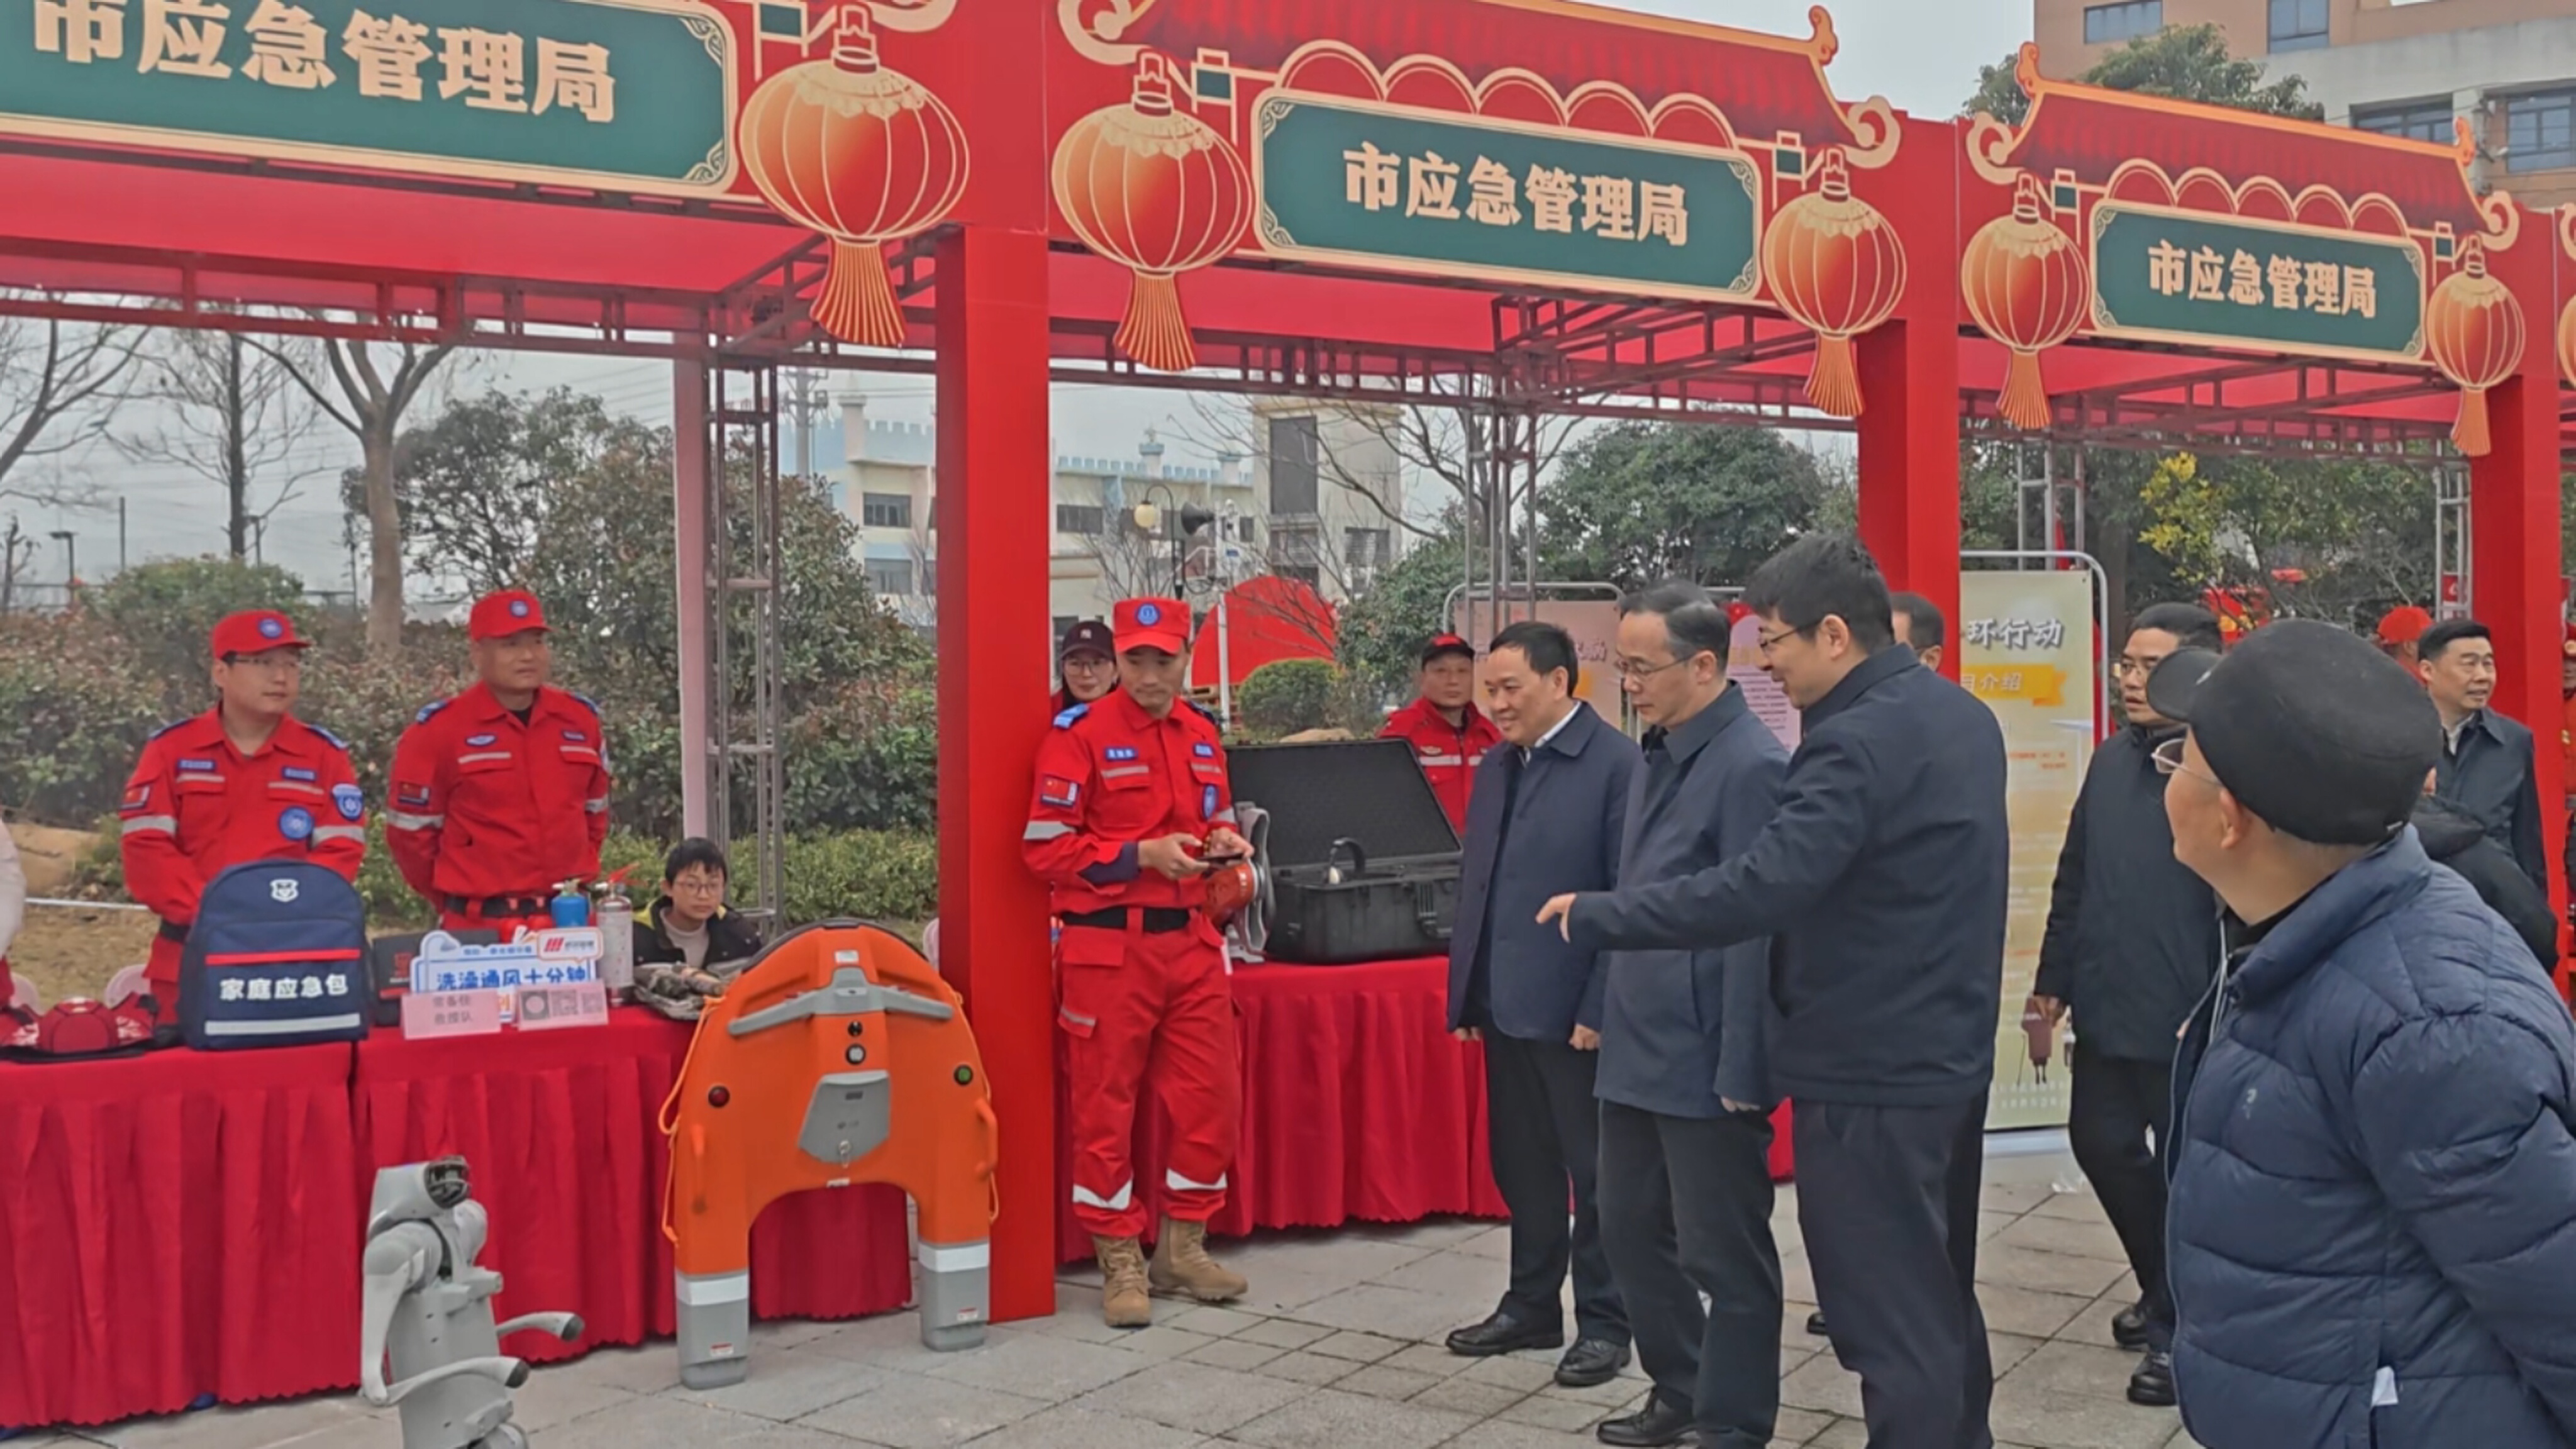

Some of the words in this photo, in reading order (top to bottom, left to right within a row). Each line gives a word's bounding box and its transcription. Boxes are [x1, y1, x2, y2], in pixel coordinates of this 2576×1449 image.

[34, 0, 616, 123] 市应急管理局
[1343, 141, 1689, 246] 市应急管理局
[2148, 239, 2377, 318] 市应急管理局
[219, 974, 348, 1001] 家庭应急包
[436, 966, 586, 991] 洗澡通风十分钟
